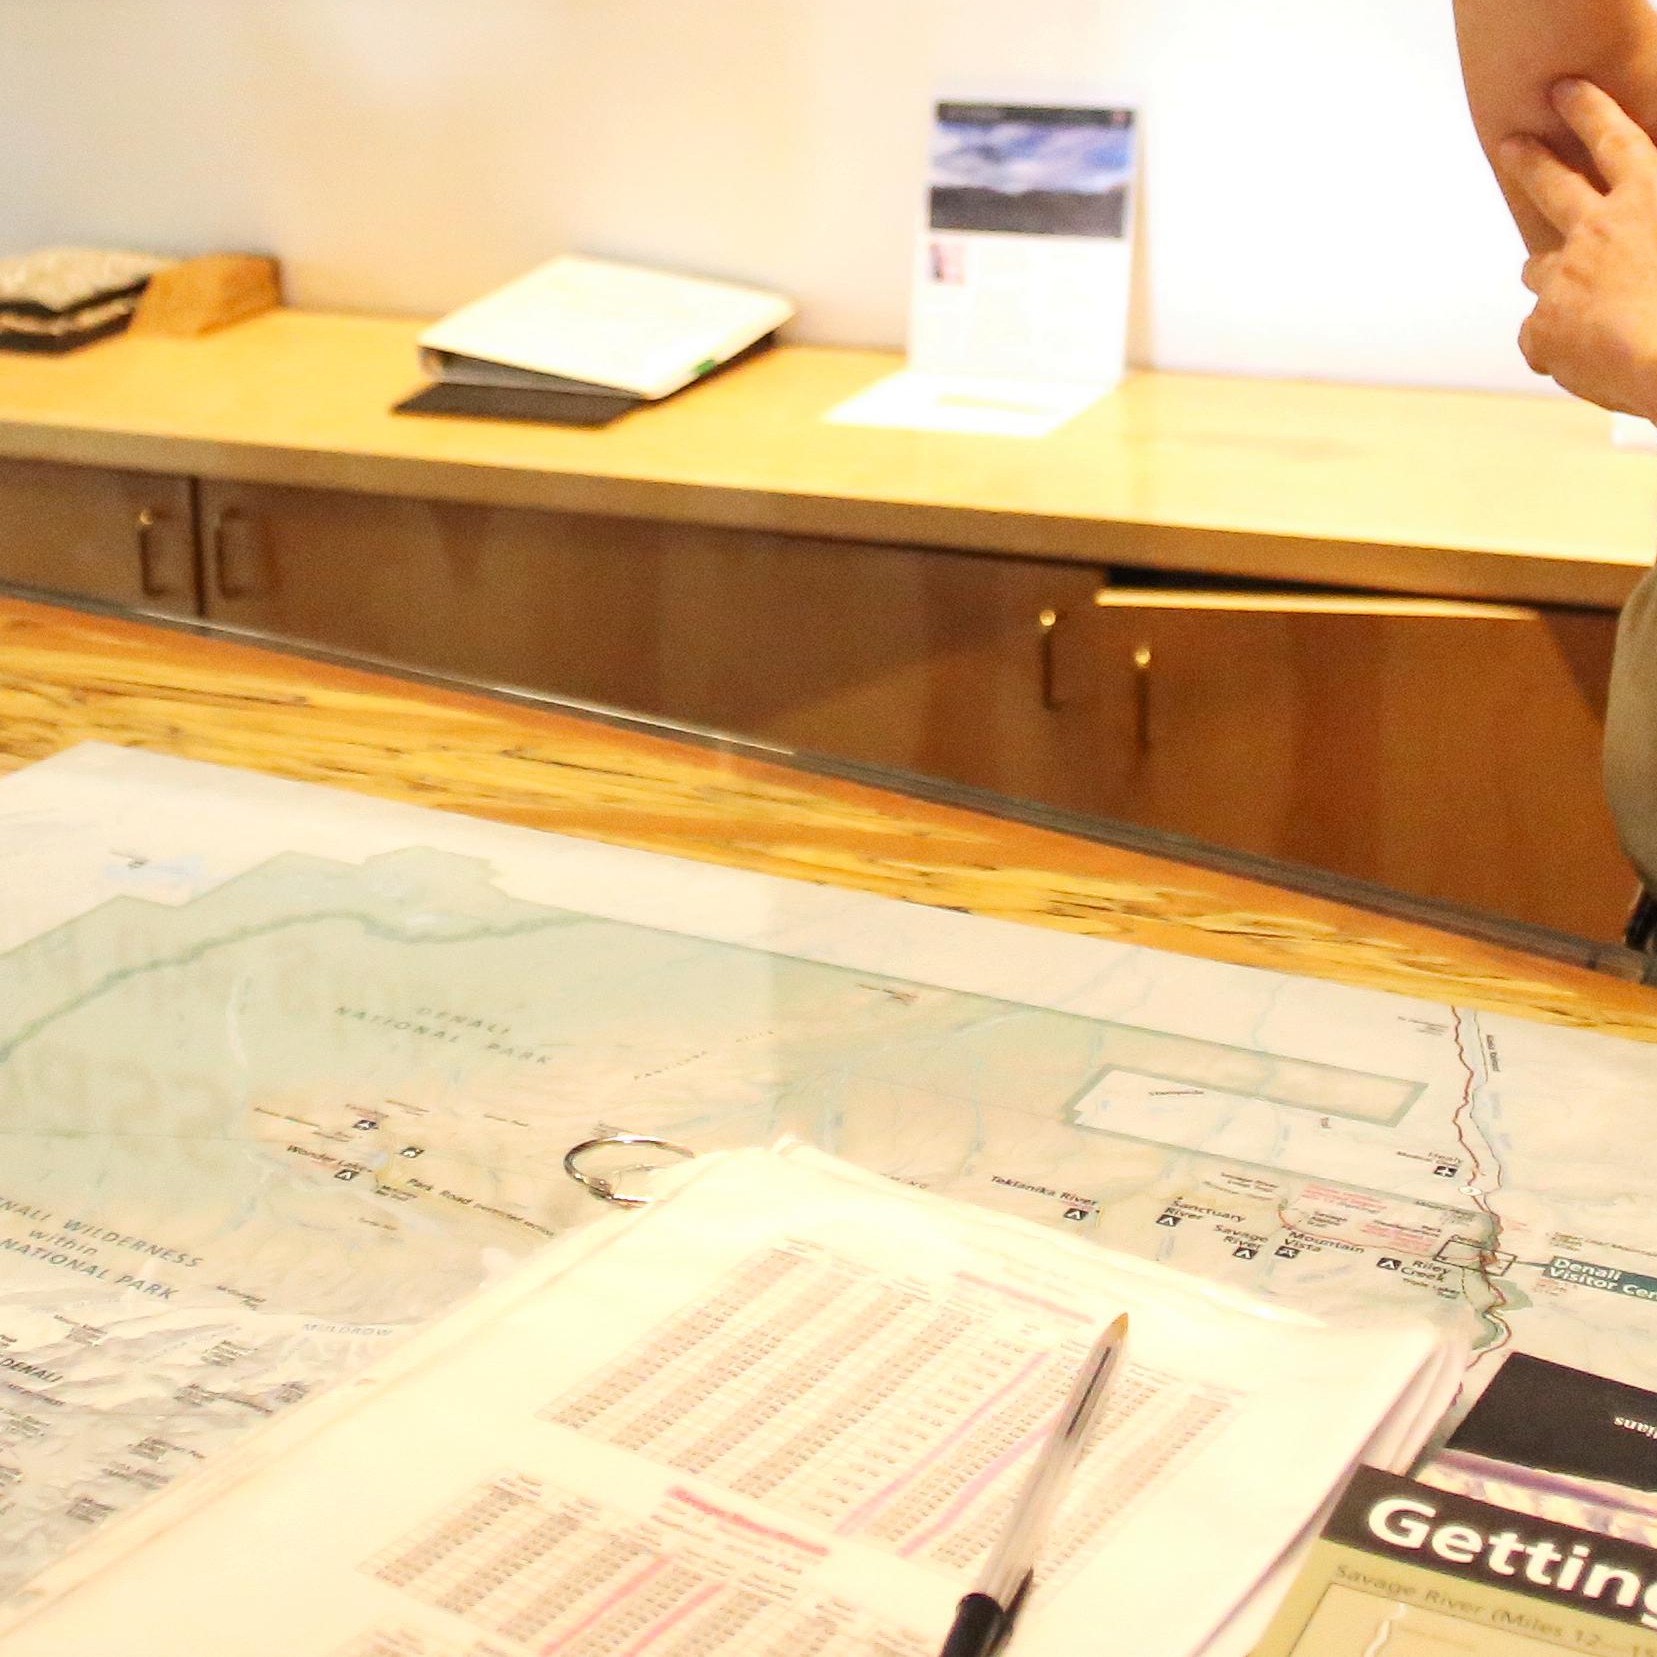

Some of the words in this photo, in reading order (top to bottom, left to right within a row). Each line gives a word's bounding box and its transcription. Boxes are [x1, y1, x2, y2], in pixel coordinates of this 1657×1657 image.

[1172, 1199, 1246, 1224] Sanctuary
[0, 1198, 51, 1223] NALI
[63, 1219, 204, 1268] WILDERNESS
[28, 1230, 98, 1255] within
[2, 1239, 109, 1281] NATIONAL
[114, 1274, 179, 1300] PARK
[1549, 1267, 1619, 1292] Visitor
[1553, 1256, 1622, 1282] Denali
[1336, 1564, 1419, 1600] Savage
[1424, 1588, 1483, 1614] River
[1491, 1607, 1564, 1637] (Miles
[1576, 1628, 1601, 1647] 12
